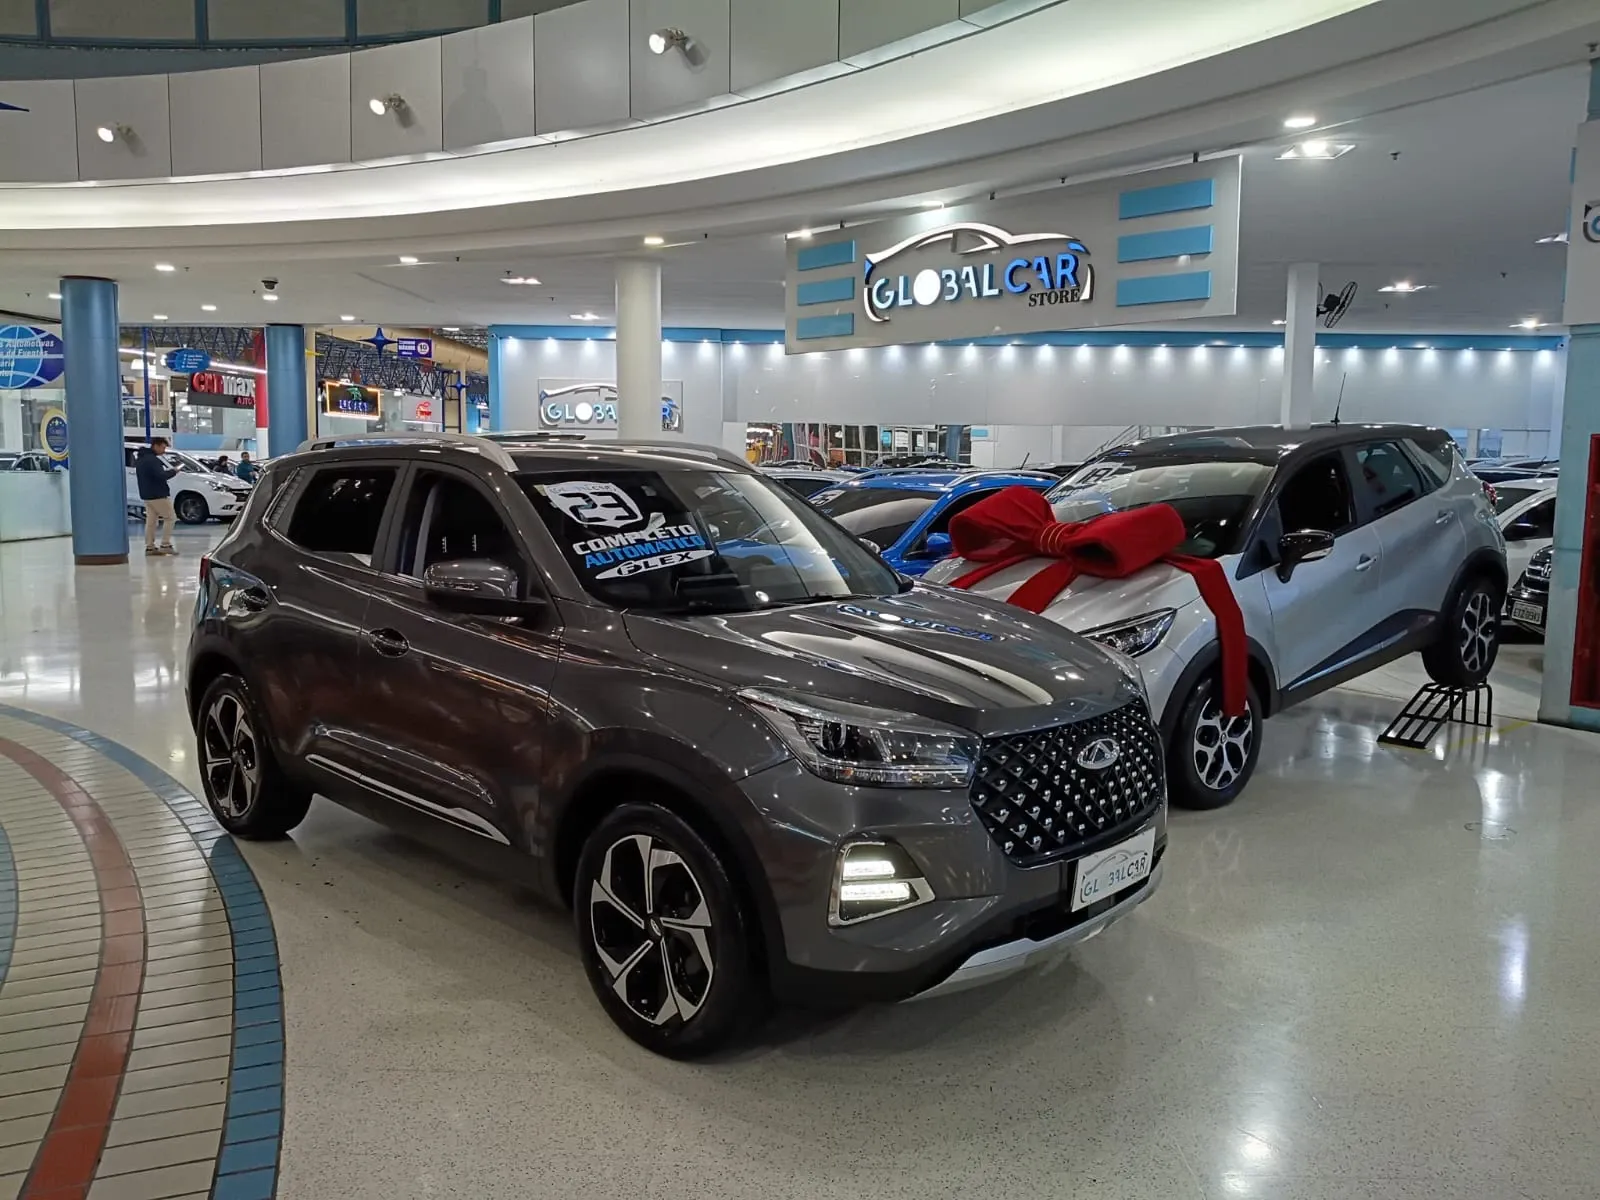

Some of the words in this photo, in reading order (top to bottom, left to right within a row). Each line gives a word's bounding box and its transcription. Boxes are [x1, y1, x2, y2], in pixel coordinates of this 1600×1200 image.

[1028, 288, 1081, 307] STORE
[6, 340, 54, 348] Automotivas
[558, 491, 639, 522] 23
[572, 524, 696, 556] COMPLETO
[585, 535, 705, 569] AUTOMATICO
[616, 551, 693, 577] FLEX
